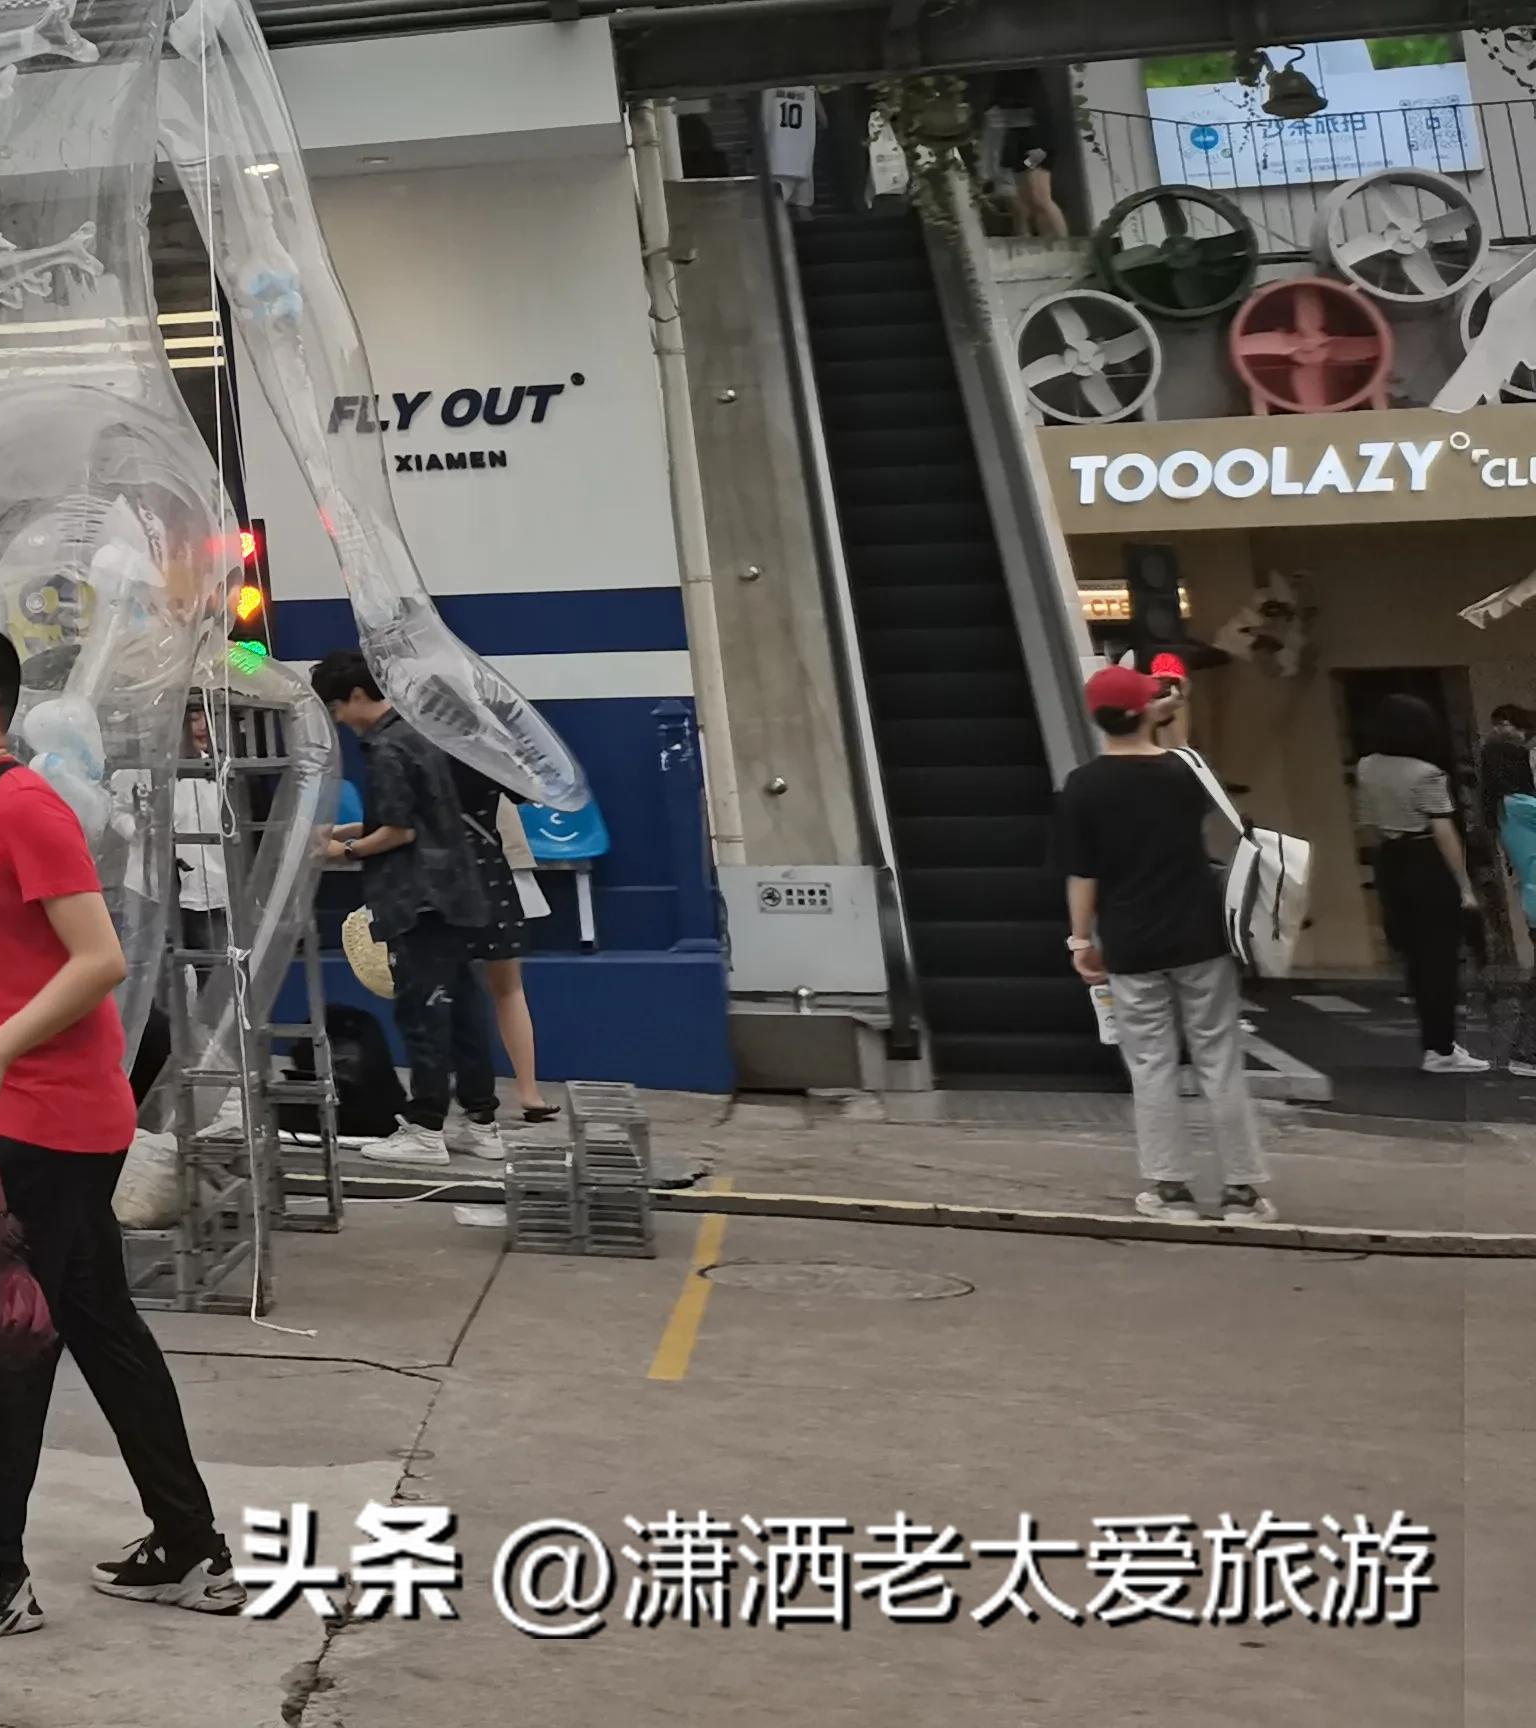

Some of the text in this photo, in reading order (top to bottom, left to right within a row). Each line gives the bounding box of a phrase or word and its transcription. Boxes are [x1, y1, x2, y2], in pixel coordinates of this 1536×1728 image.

[779, 102, 803, 130] 10
[440, 383, 566, 428] OUT
[394, 449, 508, 473] XIAMEN
[1069, 440, 1445, 505] TOOOLAZY
